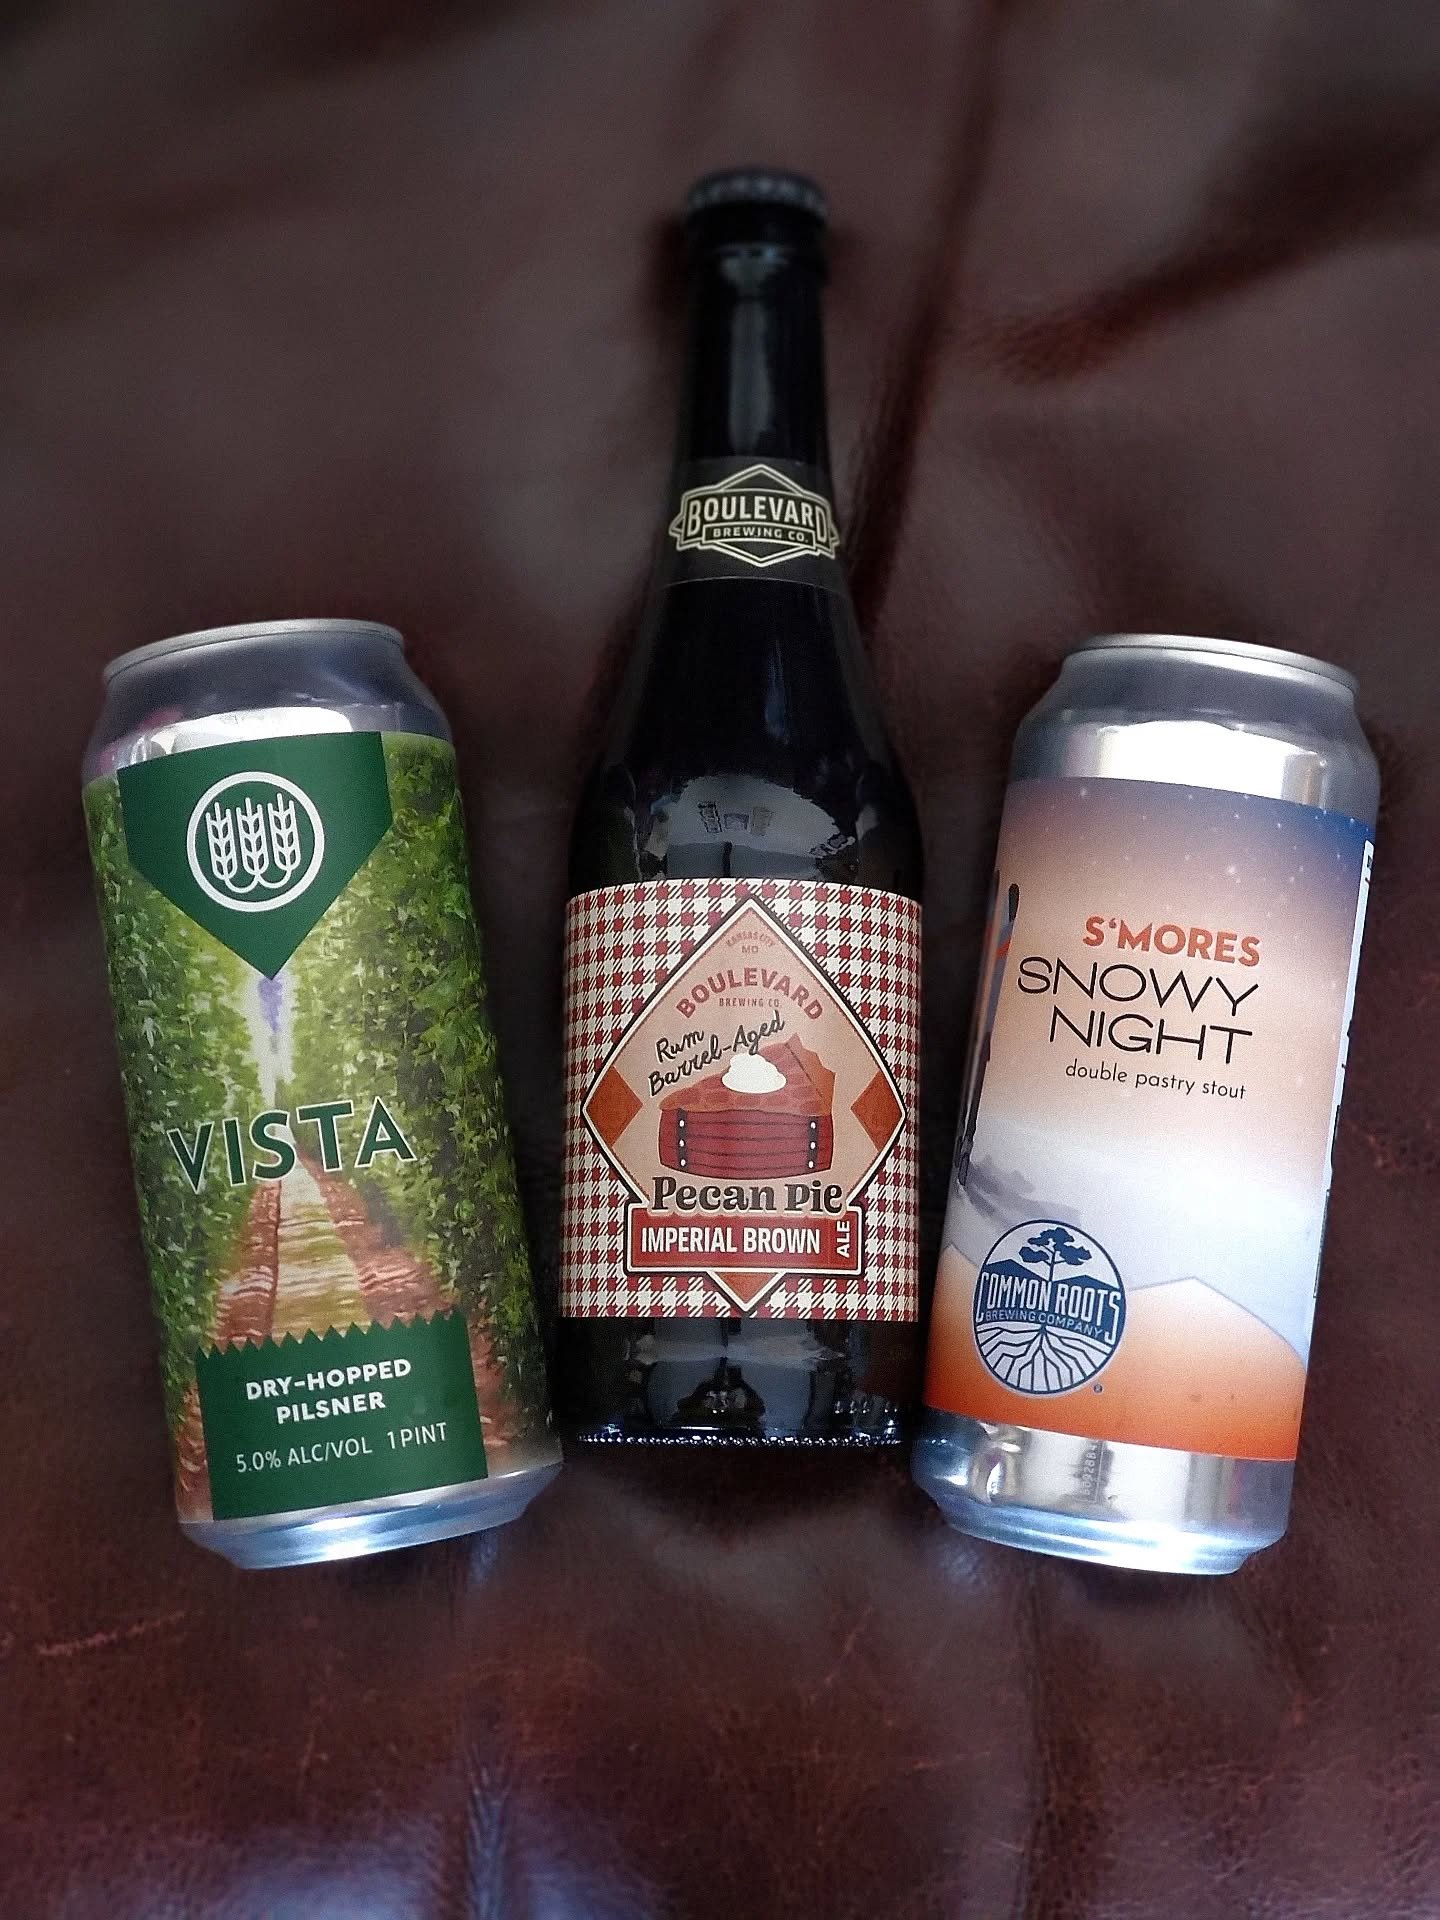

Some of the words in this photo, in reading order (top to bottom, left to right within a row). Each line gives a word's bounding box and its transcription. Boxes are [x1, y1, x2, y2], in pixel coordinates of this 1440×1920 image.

[686, 495, 827, 543] BOULEVARD
[713, 526, 782, 539] BREWING
[788, 528, 810, 543] CO.
[675, 967, 823, 1020] BOULEVARD
[718, 997, 764, 1008] BREWING
[1017, 956, 1259, 1017] SNOWY
[648, 1010, 785, 1098] Barrel-Aged
[655, 1029, 704, 1063] Rum
[1049, 1004, 1253, 1064] NIGHT
[1065, 1058, 1127, 1083] double
[1135, 1071, 1195, 1096] pastry
[1201, 1081, 1247, 1100] stout
[166, 1096, 418, 1195] VISTA
[651, 1176, 777, 1212] Pecan
[784, 1179, 843, 1213] Pie
[641, 1226, 737, 1253] IMPERIAL
[743, 1227, 820, 1254] BROWN
[836, 1220, 850, 1258] ALE
[975, 1271, 1052, 1323] COMMON
[1054, 1283, 1122, 1345] ROOTS
[985, 1309, 1036, 1321] BREWING
[1038, 1313, 1103, 1339] COMPANY
[246, 1358, 412, 1400] DRY-HOPPED
[276, 1391, 386, 1424] PILSNER
[236, 1449, 281, 1473] 5.0%
[287, 1436, 373, 1466] ALC/VOL
[401, 1422, 447, 1448] PINT
